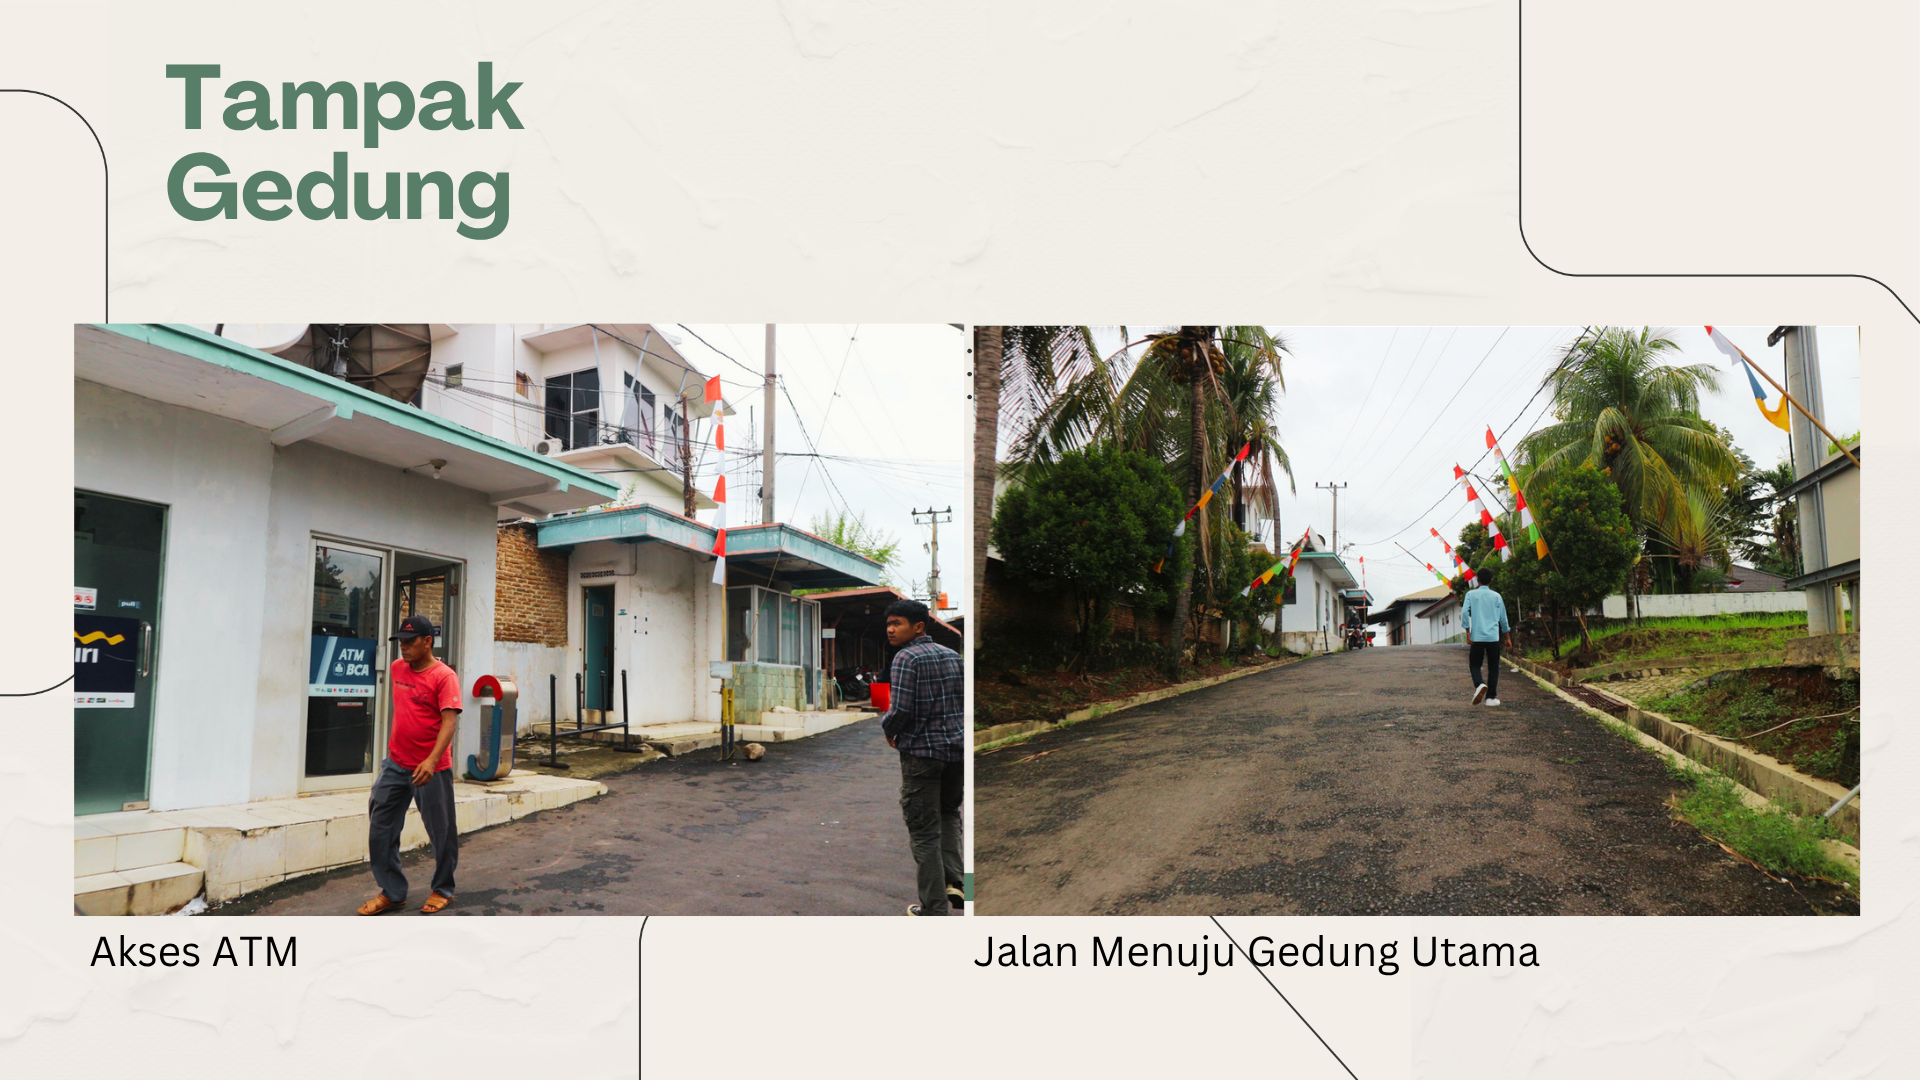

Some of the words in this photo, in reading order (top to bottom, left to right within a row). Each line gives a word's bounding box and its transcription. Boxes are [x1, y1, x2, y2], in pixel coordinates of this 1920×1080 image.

[74, 643, 99, 663] iri
[338, 648, 365, 661] ATM
[346, 664, 369, 676] BCA
